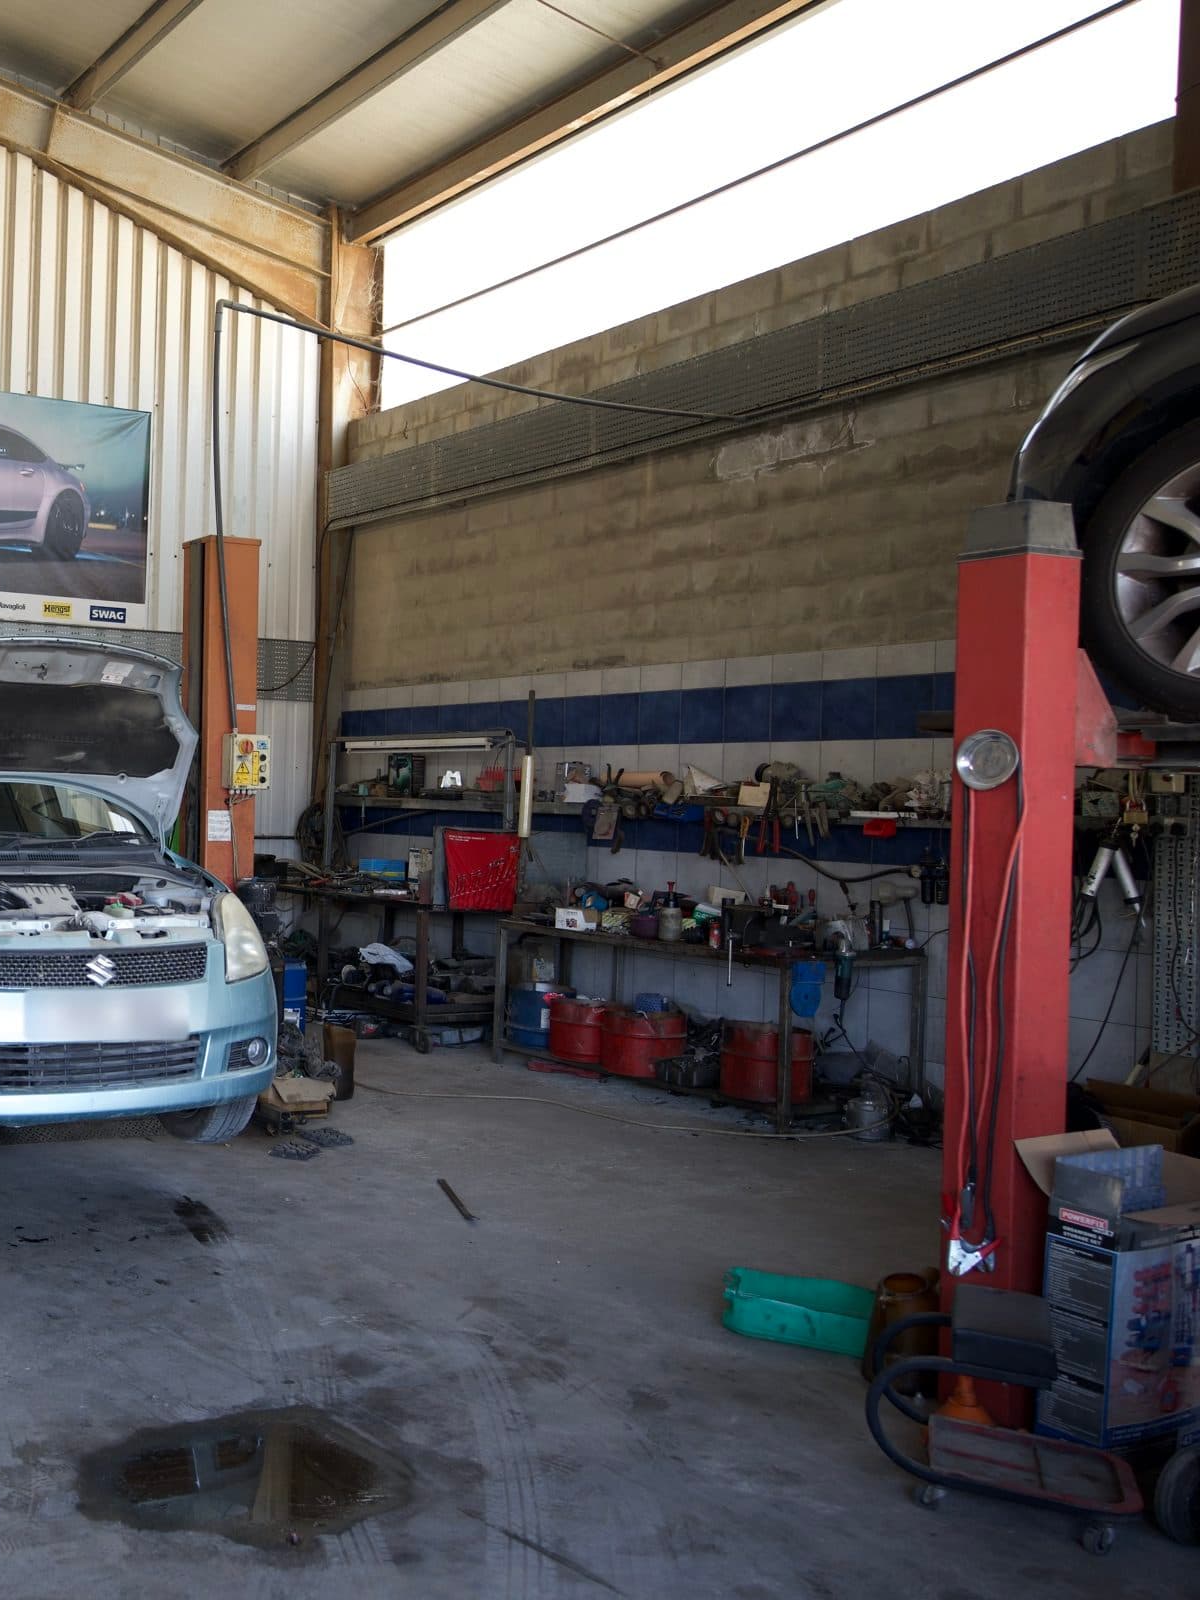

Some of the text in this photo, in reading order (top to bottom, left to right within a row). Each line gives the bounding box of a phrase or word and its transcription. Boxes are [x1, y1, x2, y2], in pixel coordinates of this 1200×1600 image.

[43, 603, 71, 614] Hengst
[91, 608, 125, 621] SWAG
[1062, 1210, 1105, 1228] POWERFIX
